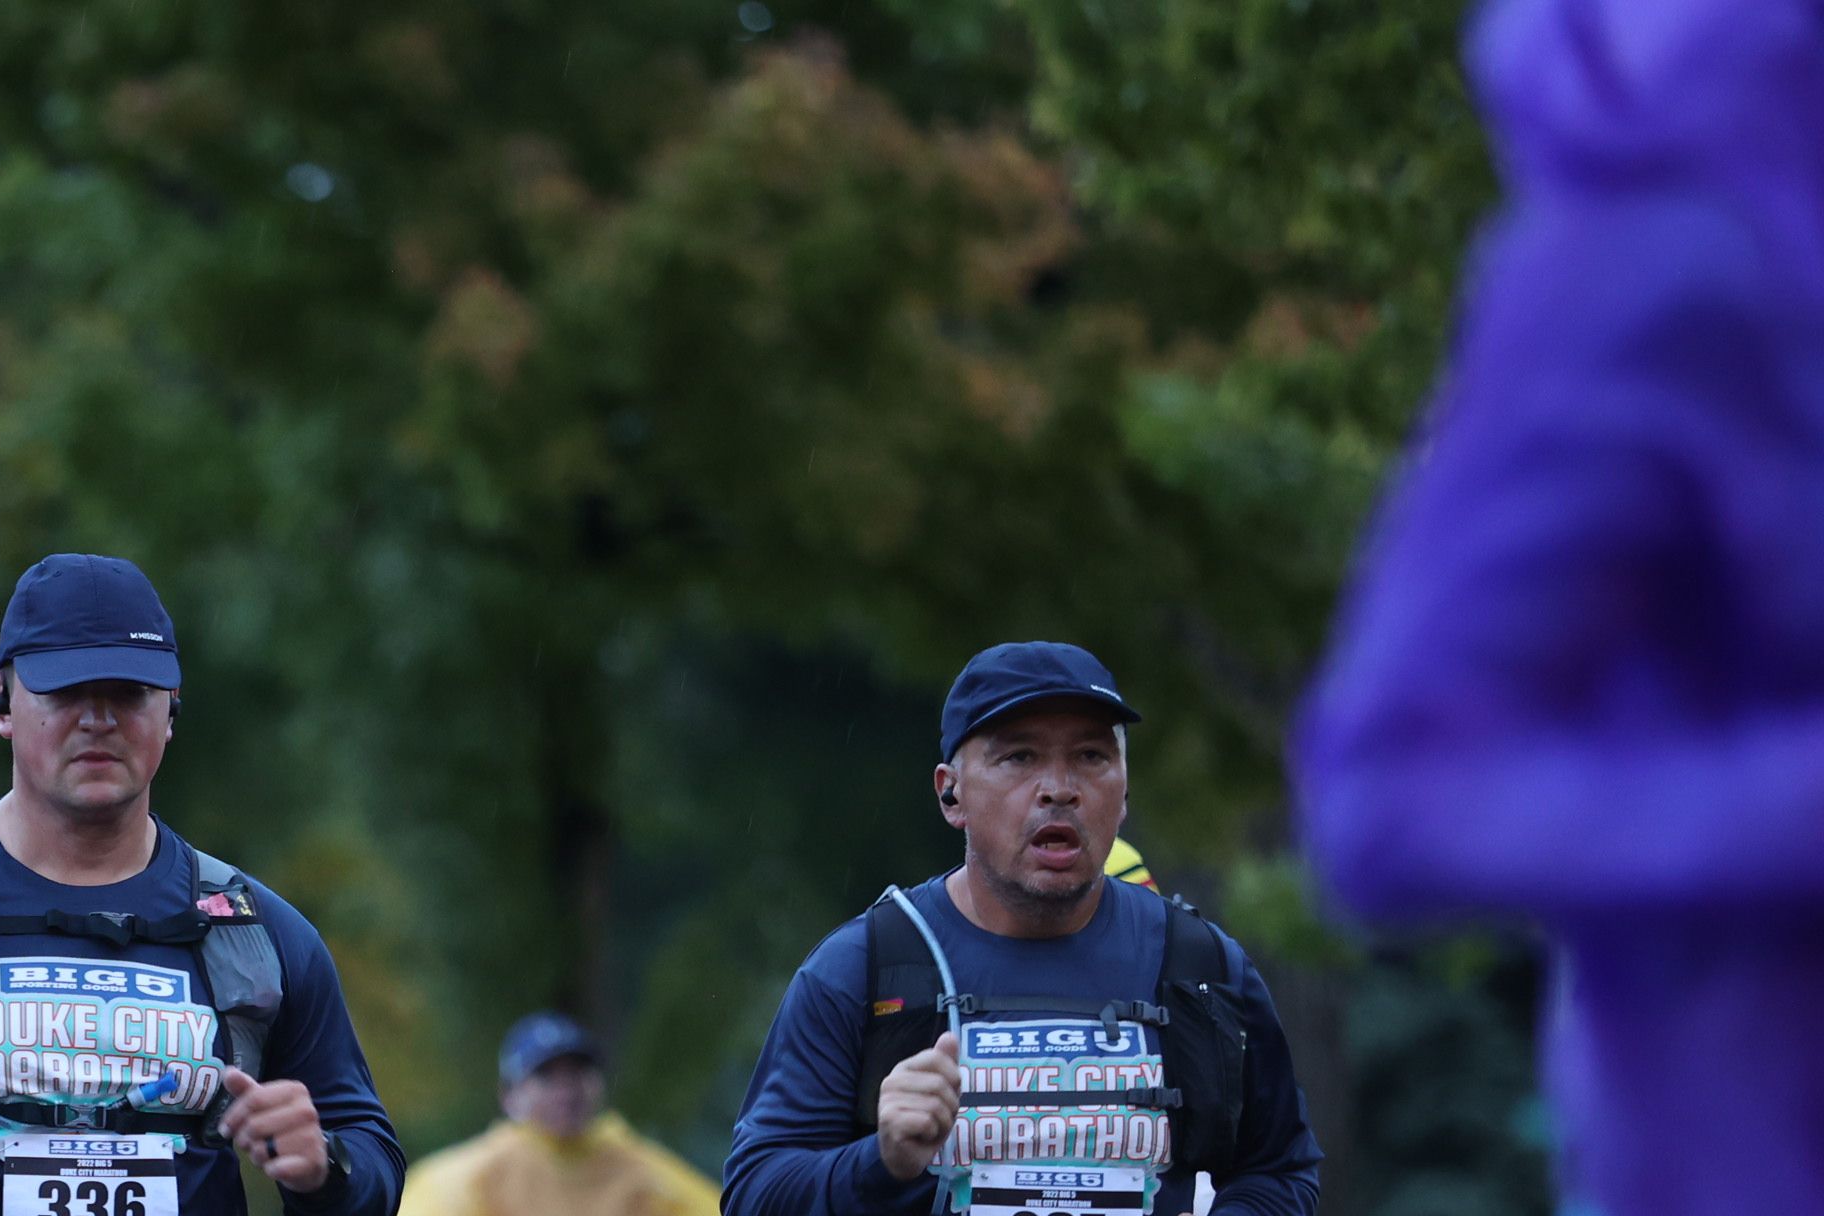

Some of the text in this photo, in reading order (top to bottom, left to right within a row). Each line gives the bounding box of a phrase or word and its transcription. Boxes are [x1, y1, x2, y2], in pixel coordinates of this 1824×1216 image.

[9, 967, 176, 997] BIG 5
[9, 982, 128, 993] SPORTING GOODS
[113, 1005, 212, 1061] CITY
[976, 1029, 1087, 1047] BIG
[977, 1044, 1088, 1054] SPORTING GOODS
[51, 1141, 113, 1151] BIG
[116, 1142, 137, 1155] 5
[1016, 1173, 1077, 1183] BIG
[1080, 1174, 1102, 1187] 5
